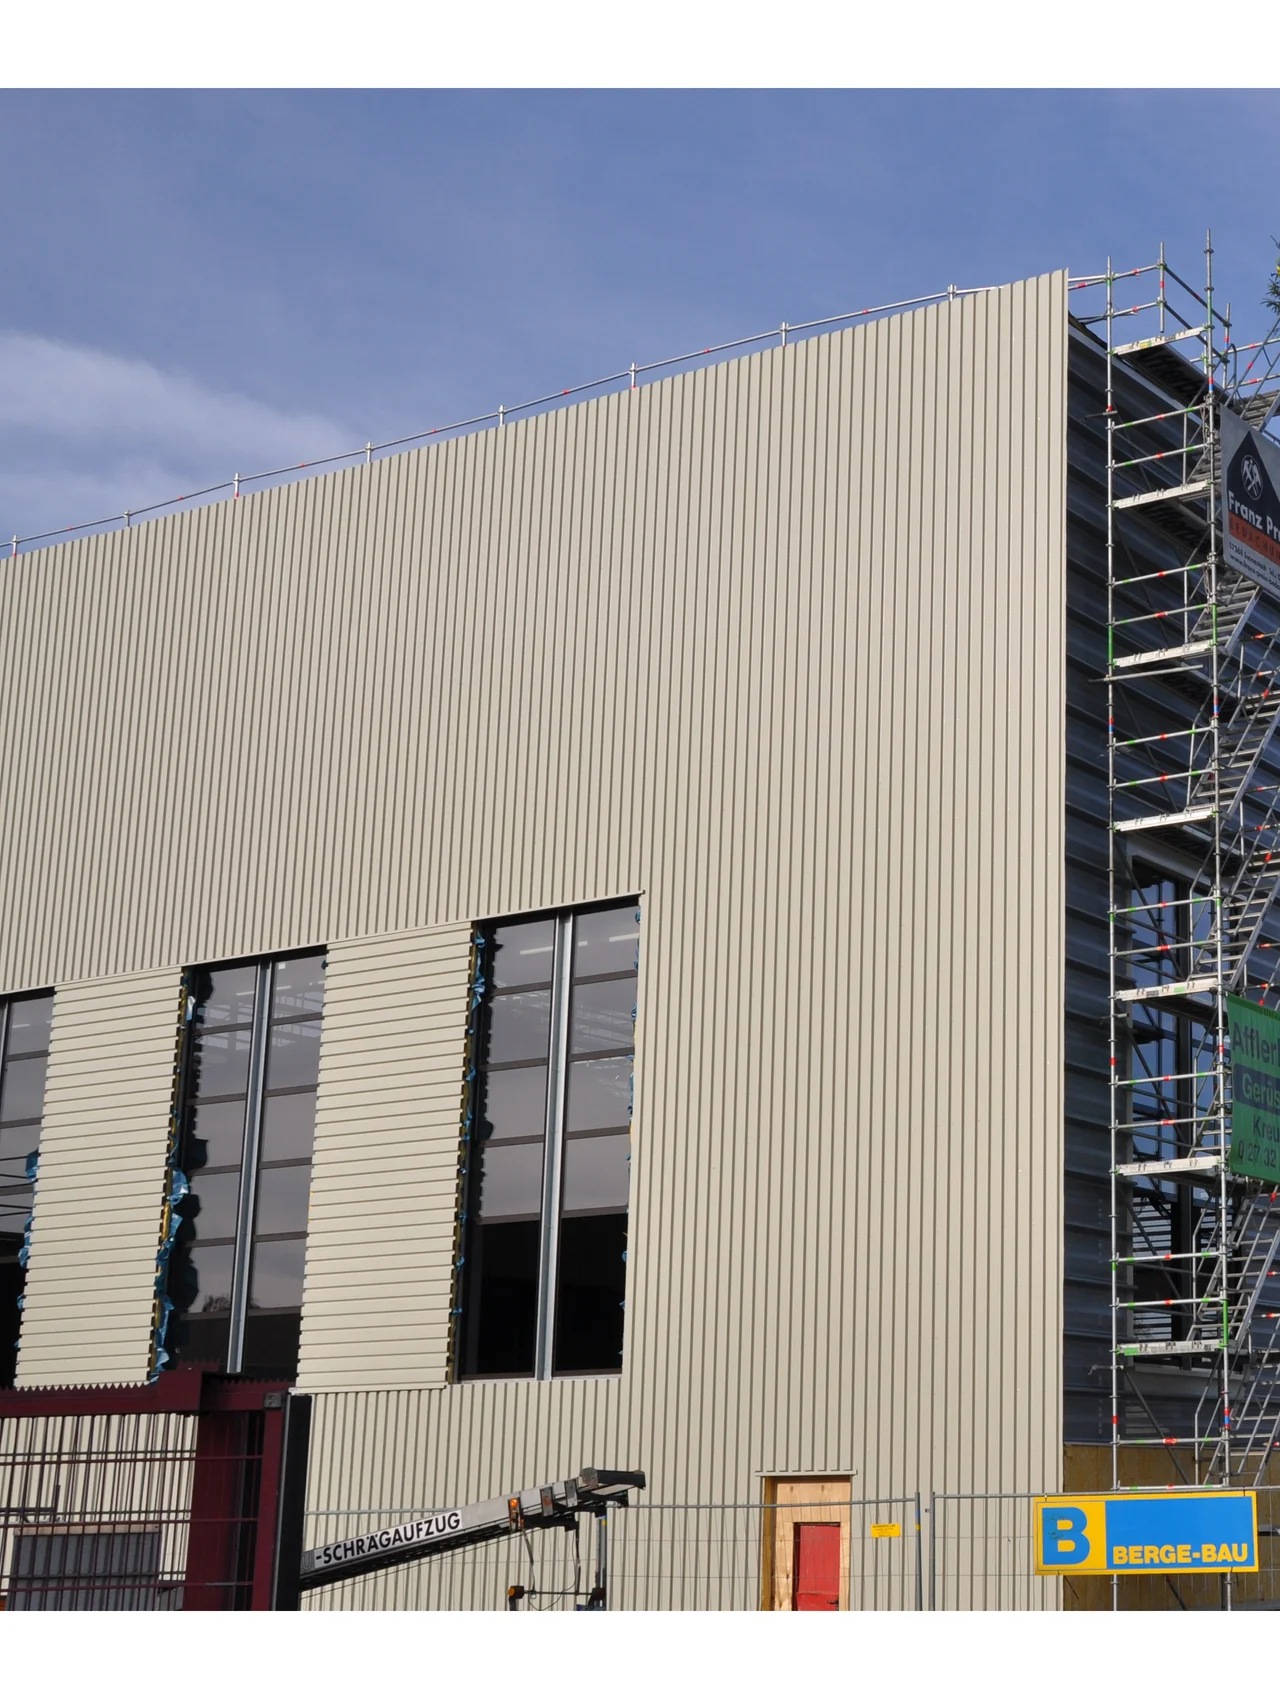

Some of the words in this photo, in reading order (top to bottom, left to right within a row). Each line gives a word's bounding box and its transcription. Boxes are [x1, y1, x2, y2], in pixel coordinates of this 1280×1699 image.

[1228, 490, 1263, 530] Franz
[1042, 1506, 1091, 1566] B
[1112, 1543, 1249, 1565] BERGE-BAU
